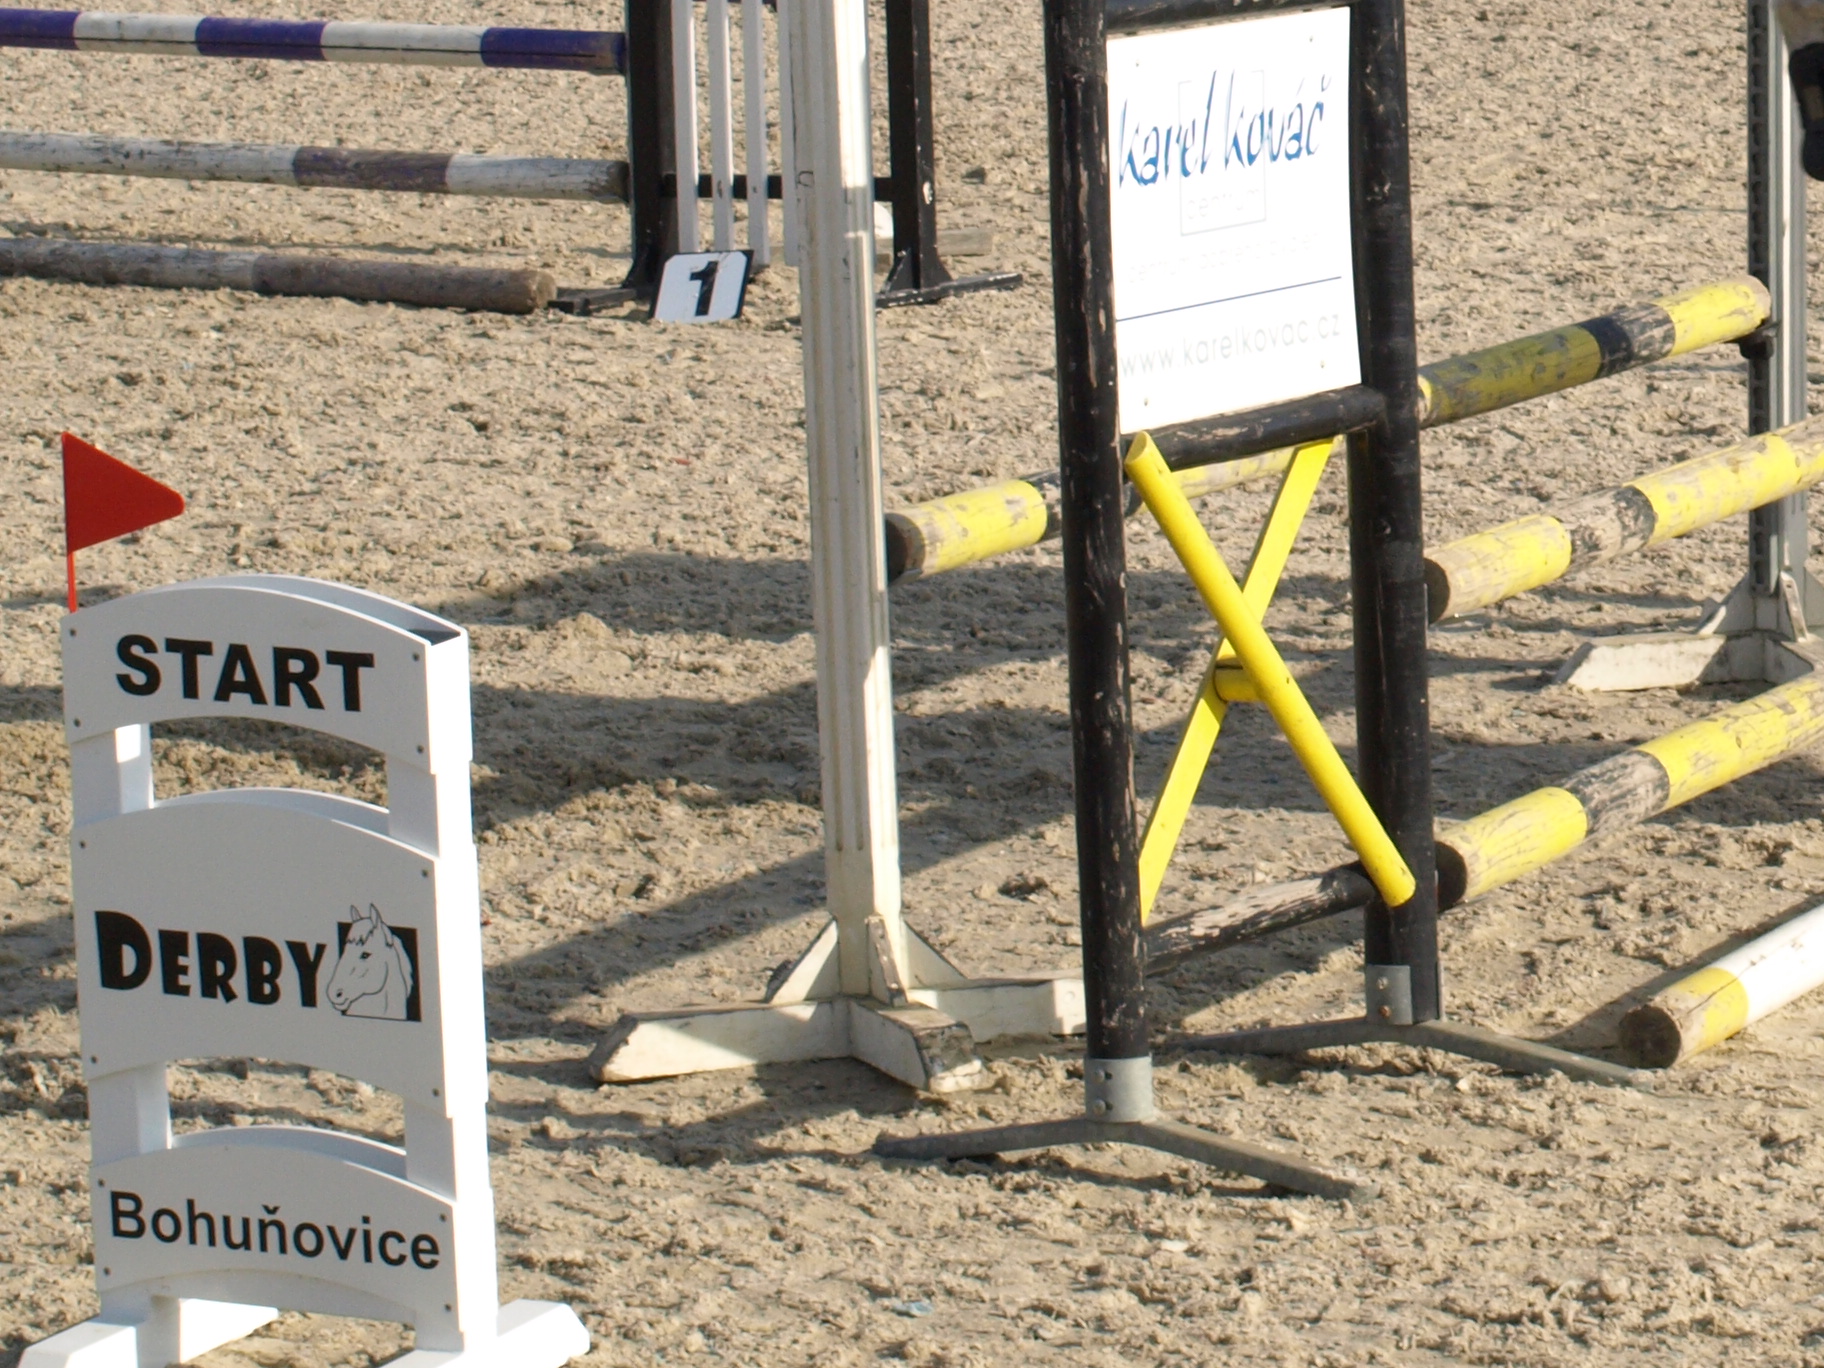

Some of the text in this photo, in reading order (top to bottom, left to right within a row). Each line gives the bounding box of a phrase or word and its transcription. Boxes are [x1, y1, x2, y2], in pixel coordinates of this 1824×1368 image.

[1118, 69, 1217, 188] karel
[689, 261, 719, 316] 1
[116, 634, 375, 713] START
[94, 910, 326, 1008] DERBY
[109, 1190, 441, 1270] Bohuňovice
